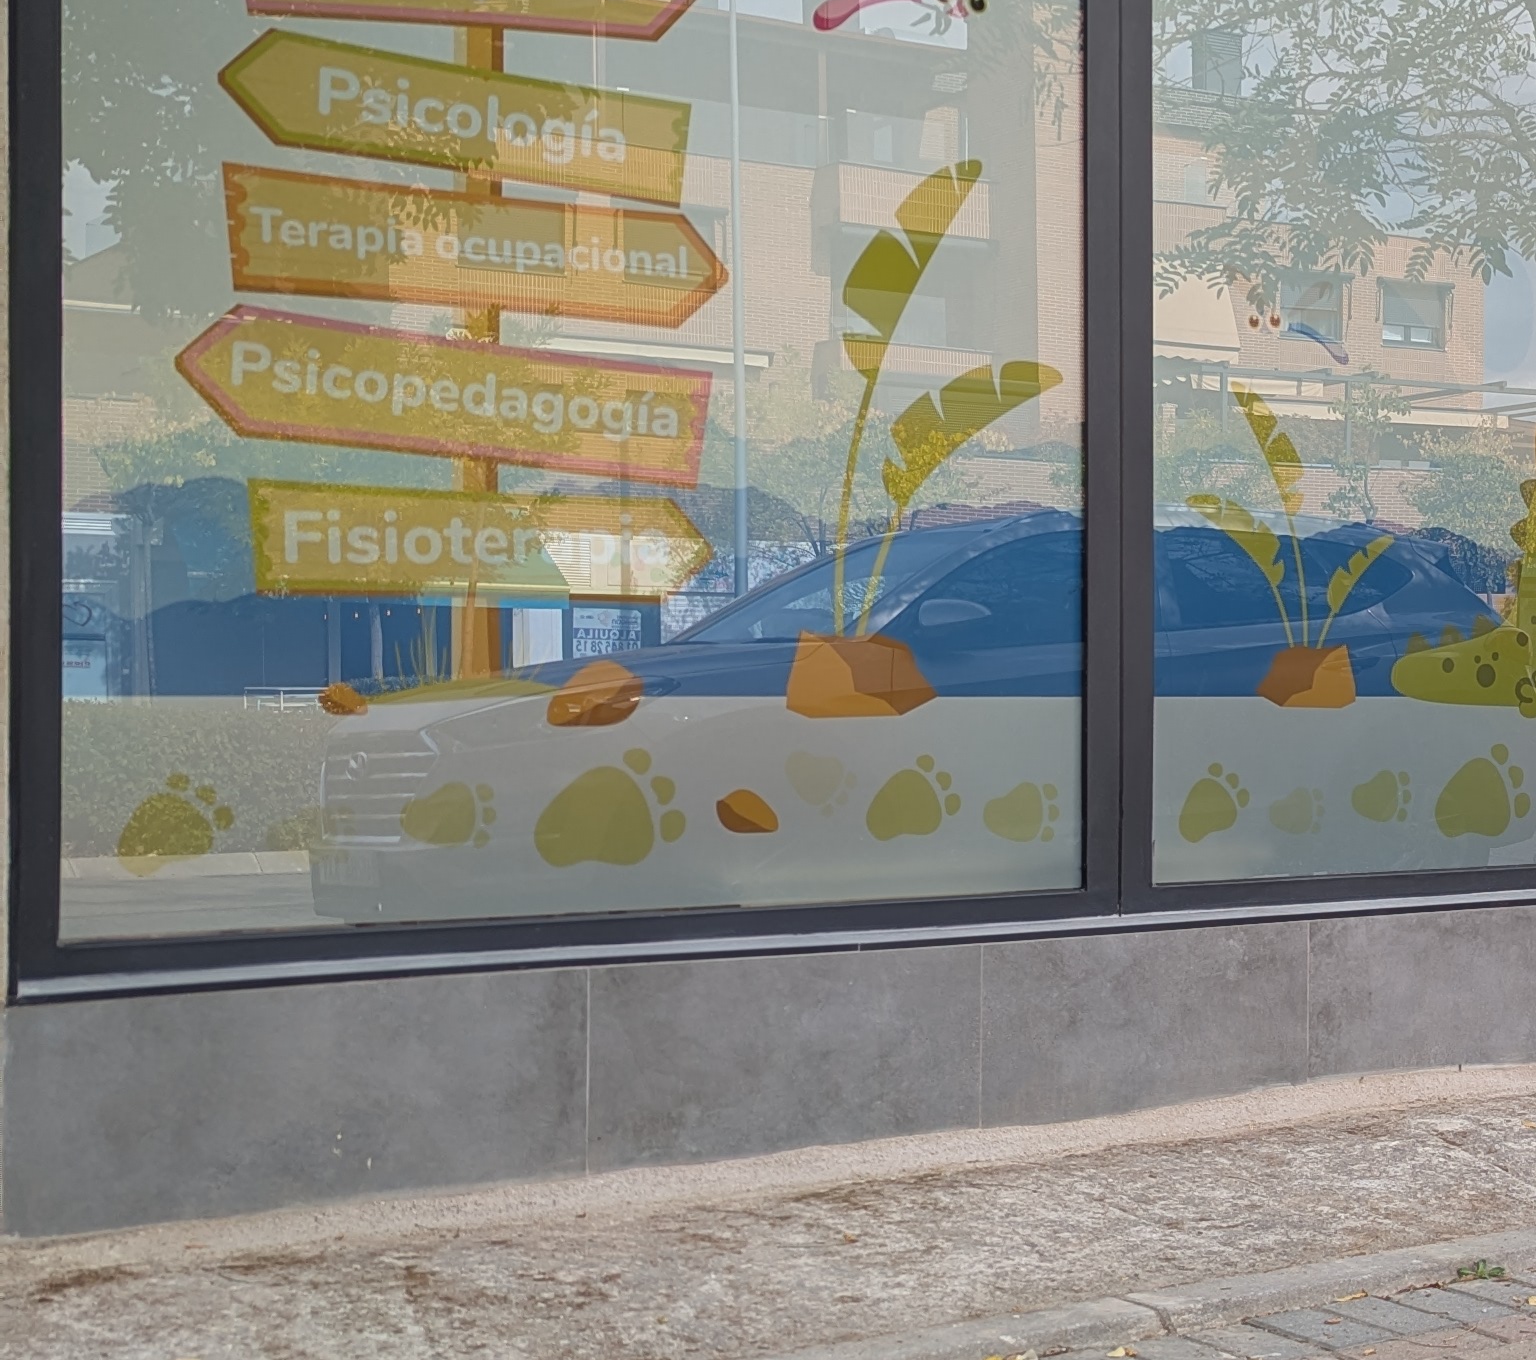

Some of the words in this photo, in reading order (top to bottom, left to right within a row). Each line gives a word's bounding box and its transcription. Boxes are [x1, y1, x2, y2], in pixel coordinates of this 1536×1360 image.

[317, 65, 627, 165] Psicología
[249, 205, 426, 259] Terapia
[434, 232, 688, 281] ocupacional
[230, 341, 679, 444] Psicopedagogía
